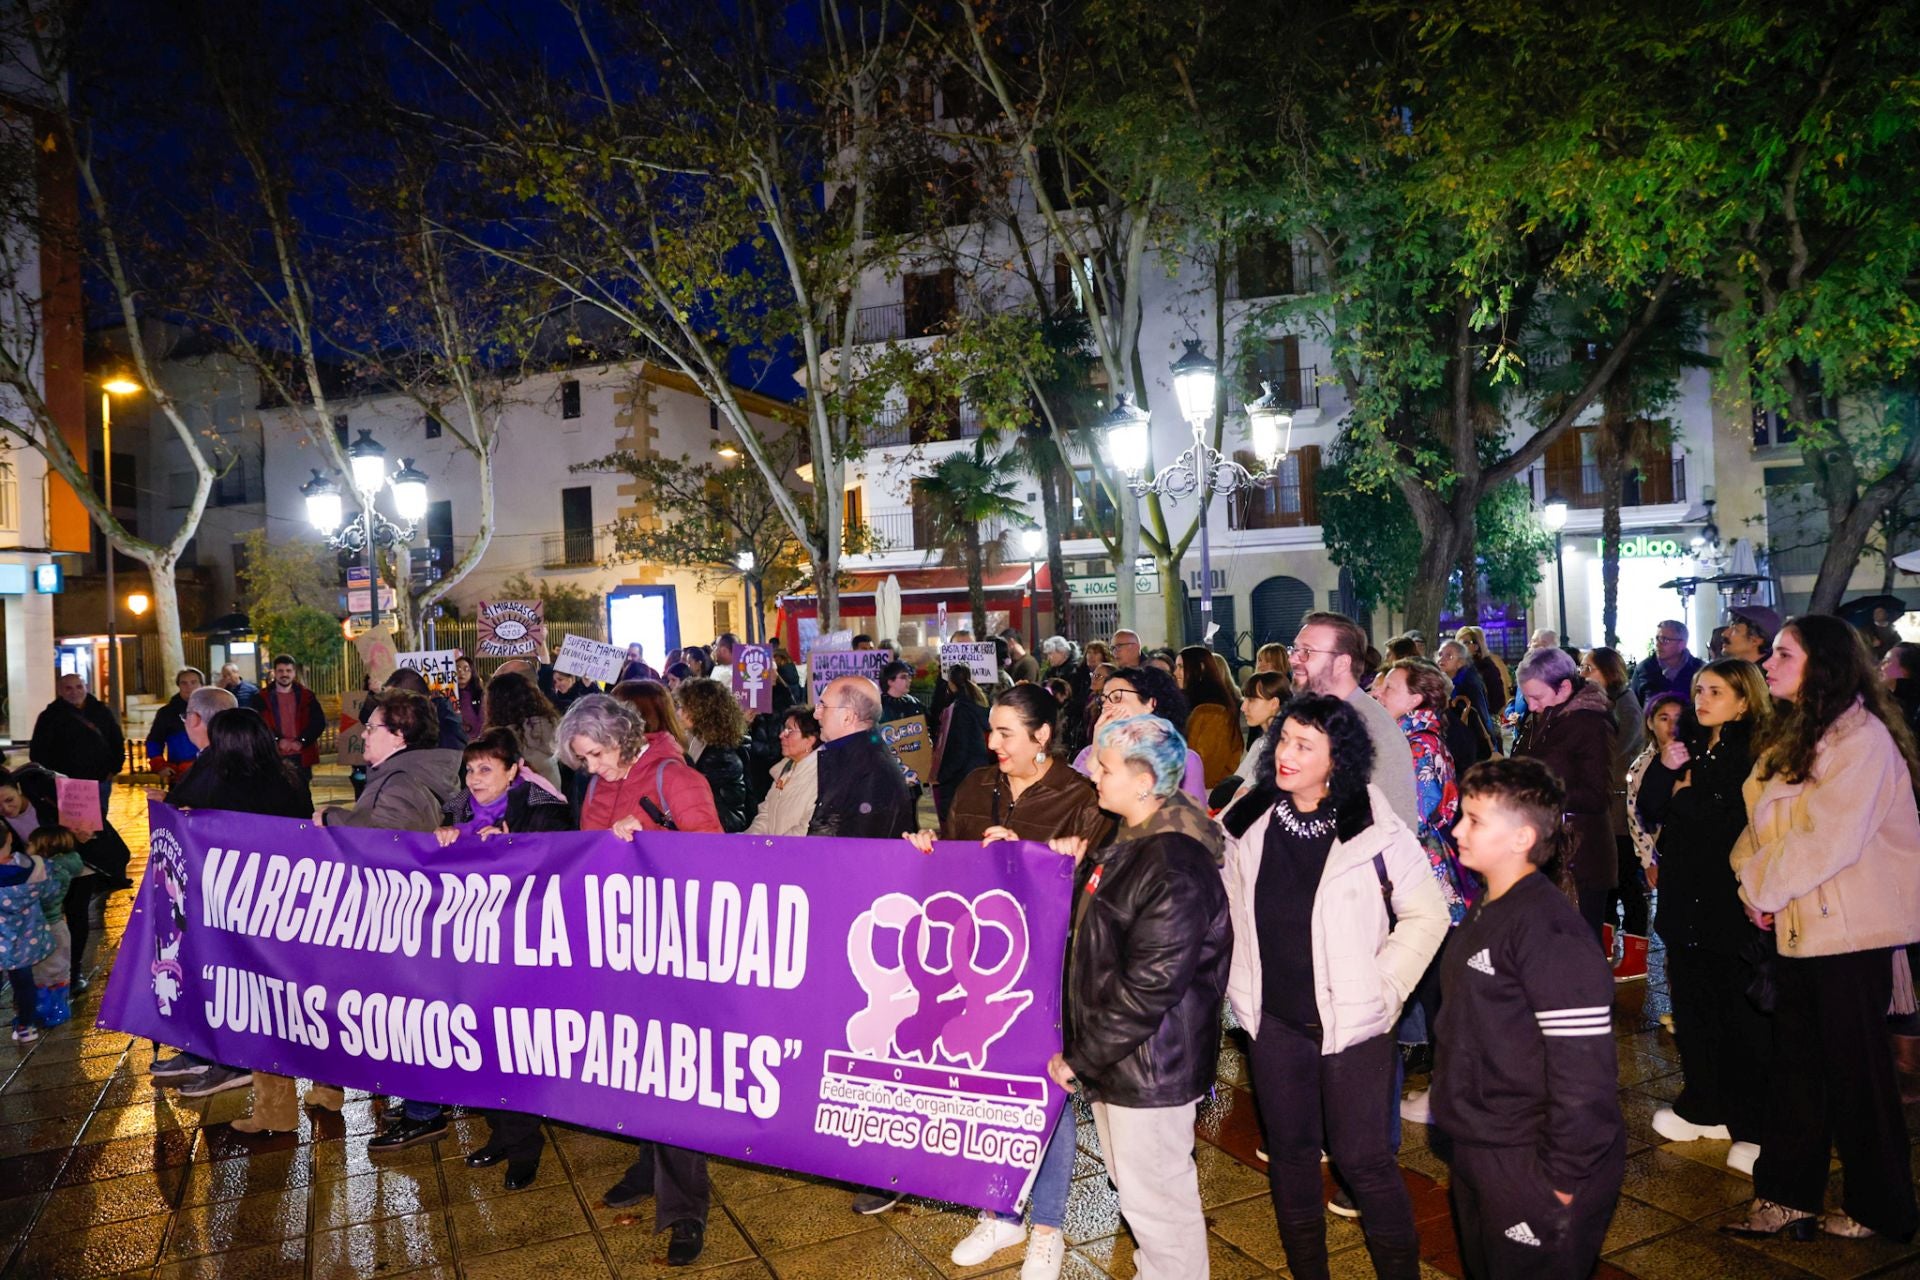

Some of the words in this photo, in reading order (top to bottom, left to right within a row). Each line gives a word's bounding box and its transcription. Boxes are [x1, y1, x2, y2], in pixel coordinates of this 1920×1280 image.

[1085, 582, 1117, 594] HOUS
[400, 657, 440, 673] CAUSA
[830, 653, 889, 669] CALLADAS
[202, 847, 432, 958] MARCHANDO
[431, 872, 512, 965] POR
[514, 874, 573, 967] LA
[584, 873, 810, 990] IGUALDAD
[337, 989, 483, 1072] SOMOS
[822, 1080, 891, 1105] Federación
[894, 1092, 912, 1108] de
[916, 1095, 1019, 1124] organizaciones
[1024, 1109, 1043, 1128] de
[817, 1107, 917, 1144] mujeres
[925, 1117, 958, 1151] de
[967, 1124, 1038, 1165] Lorca
